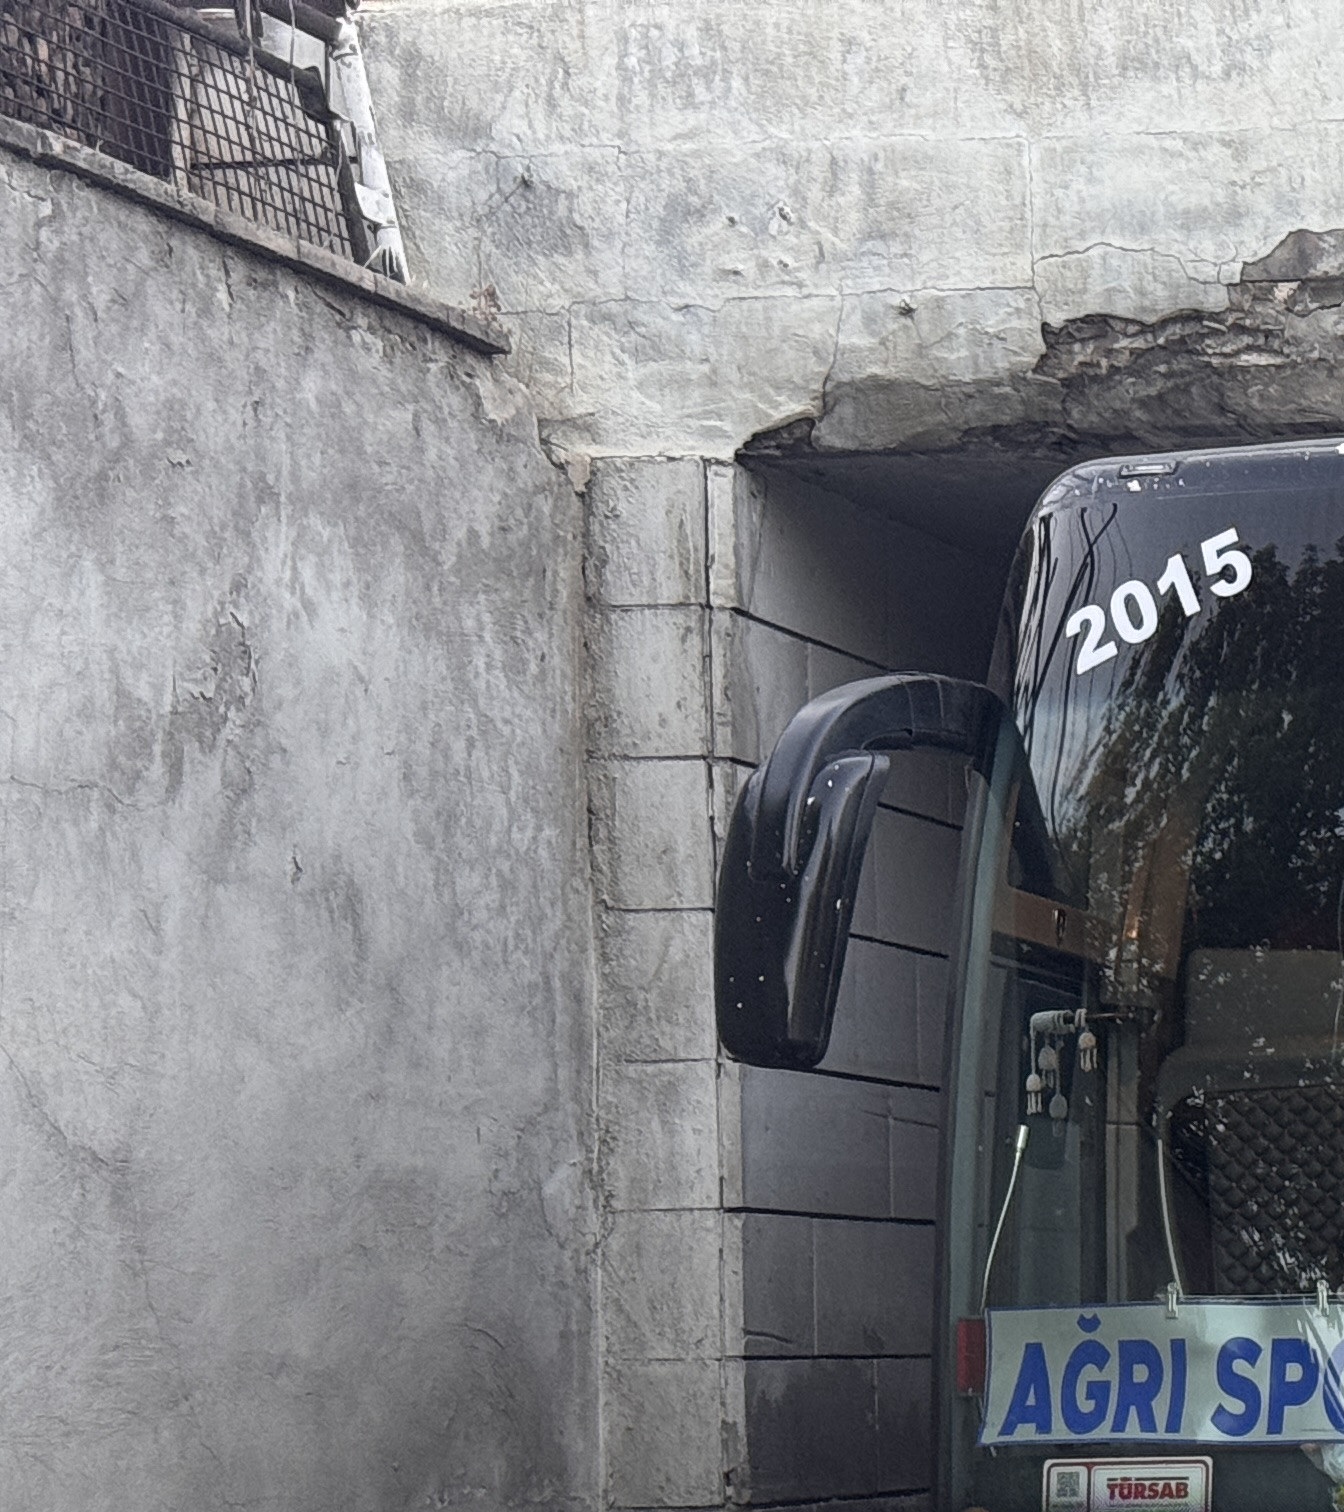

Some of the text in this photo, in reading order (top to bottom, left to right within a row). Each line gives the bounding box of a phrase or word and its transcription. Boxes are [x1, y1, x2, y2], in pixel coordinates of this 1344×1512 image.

[1065, 527, 1253, 675] 2015
[998, 1313, 1187, 1436] AĞRI
[1106, 1476, 1190, 1500] TÜRSAB
